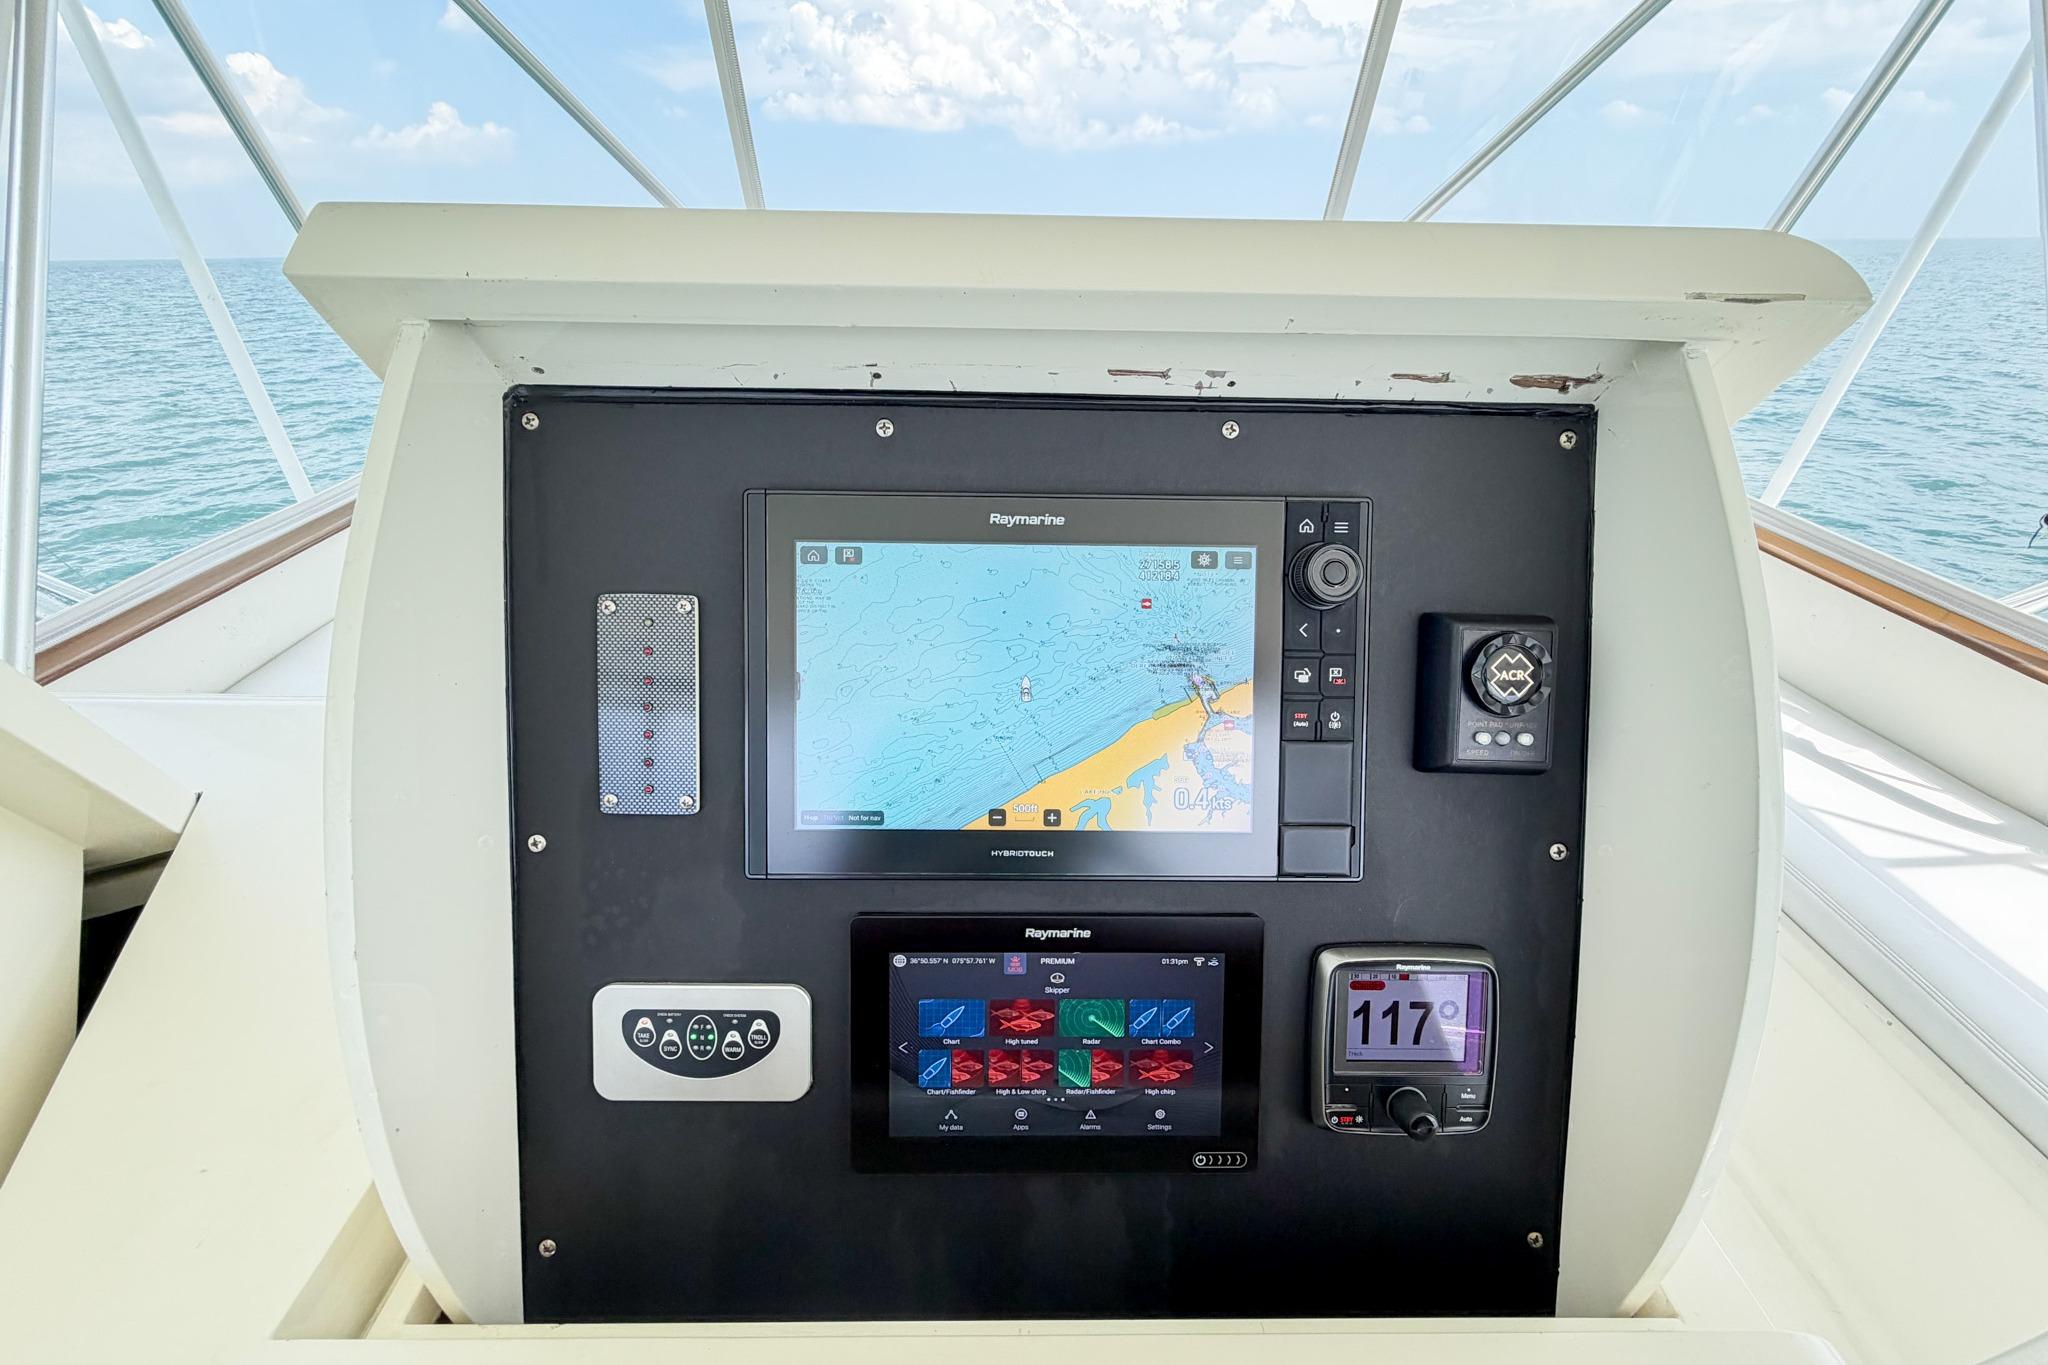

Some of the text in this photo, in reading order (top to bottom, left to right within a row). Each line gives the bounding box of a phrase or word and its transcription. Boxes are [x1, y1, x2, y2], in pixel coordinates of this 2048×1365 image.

[989, 513, 1066, 528] Raymarine
[1500, 669, 1526, 681] ACR
[1173, 787, 1233, 811] 0.4 kts
[1012, 803, 1038, 814] 500ft
[991, 849, 1054, 858] HYBRIDTOUCH
[1025, 927, 1092, 941] Raymarine
[1040, 957, 1075, 965] PREMIUM
[1161, 958, 1189, 966] 01:31pm
[1396, 963, 1432, 972] Raymarine
[1044, 985, 1070, 995] Skipper
[1005, 1038, 1020, 1046] High
[995, 1088, 1010, 1096] High
[1030, 1088, 1047, 1096] chirp
[1144, 1088, 1176, 1096] High chirp
[1460, 1092, 1477, 1100] Menu
[1459, 1115, 1473, 1123] Auto
[1012, 1124, 1029, 1132] Apps
[1079, 1123, 1101, 1131] Alarms
[1147, 1123, 1172, 1132] Settings
